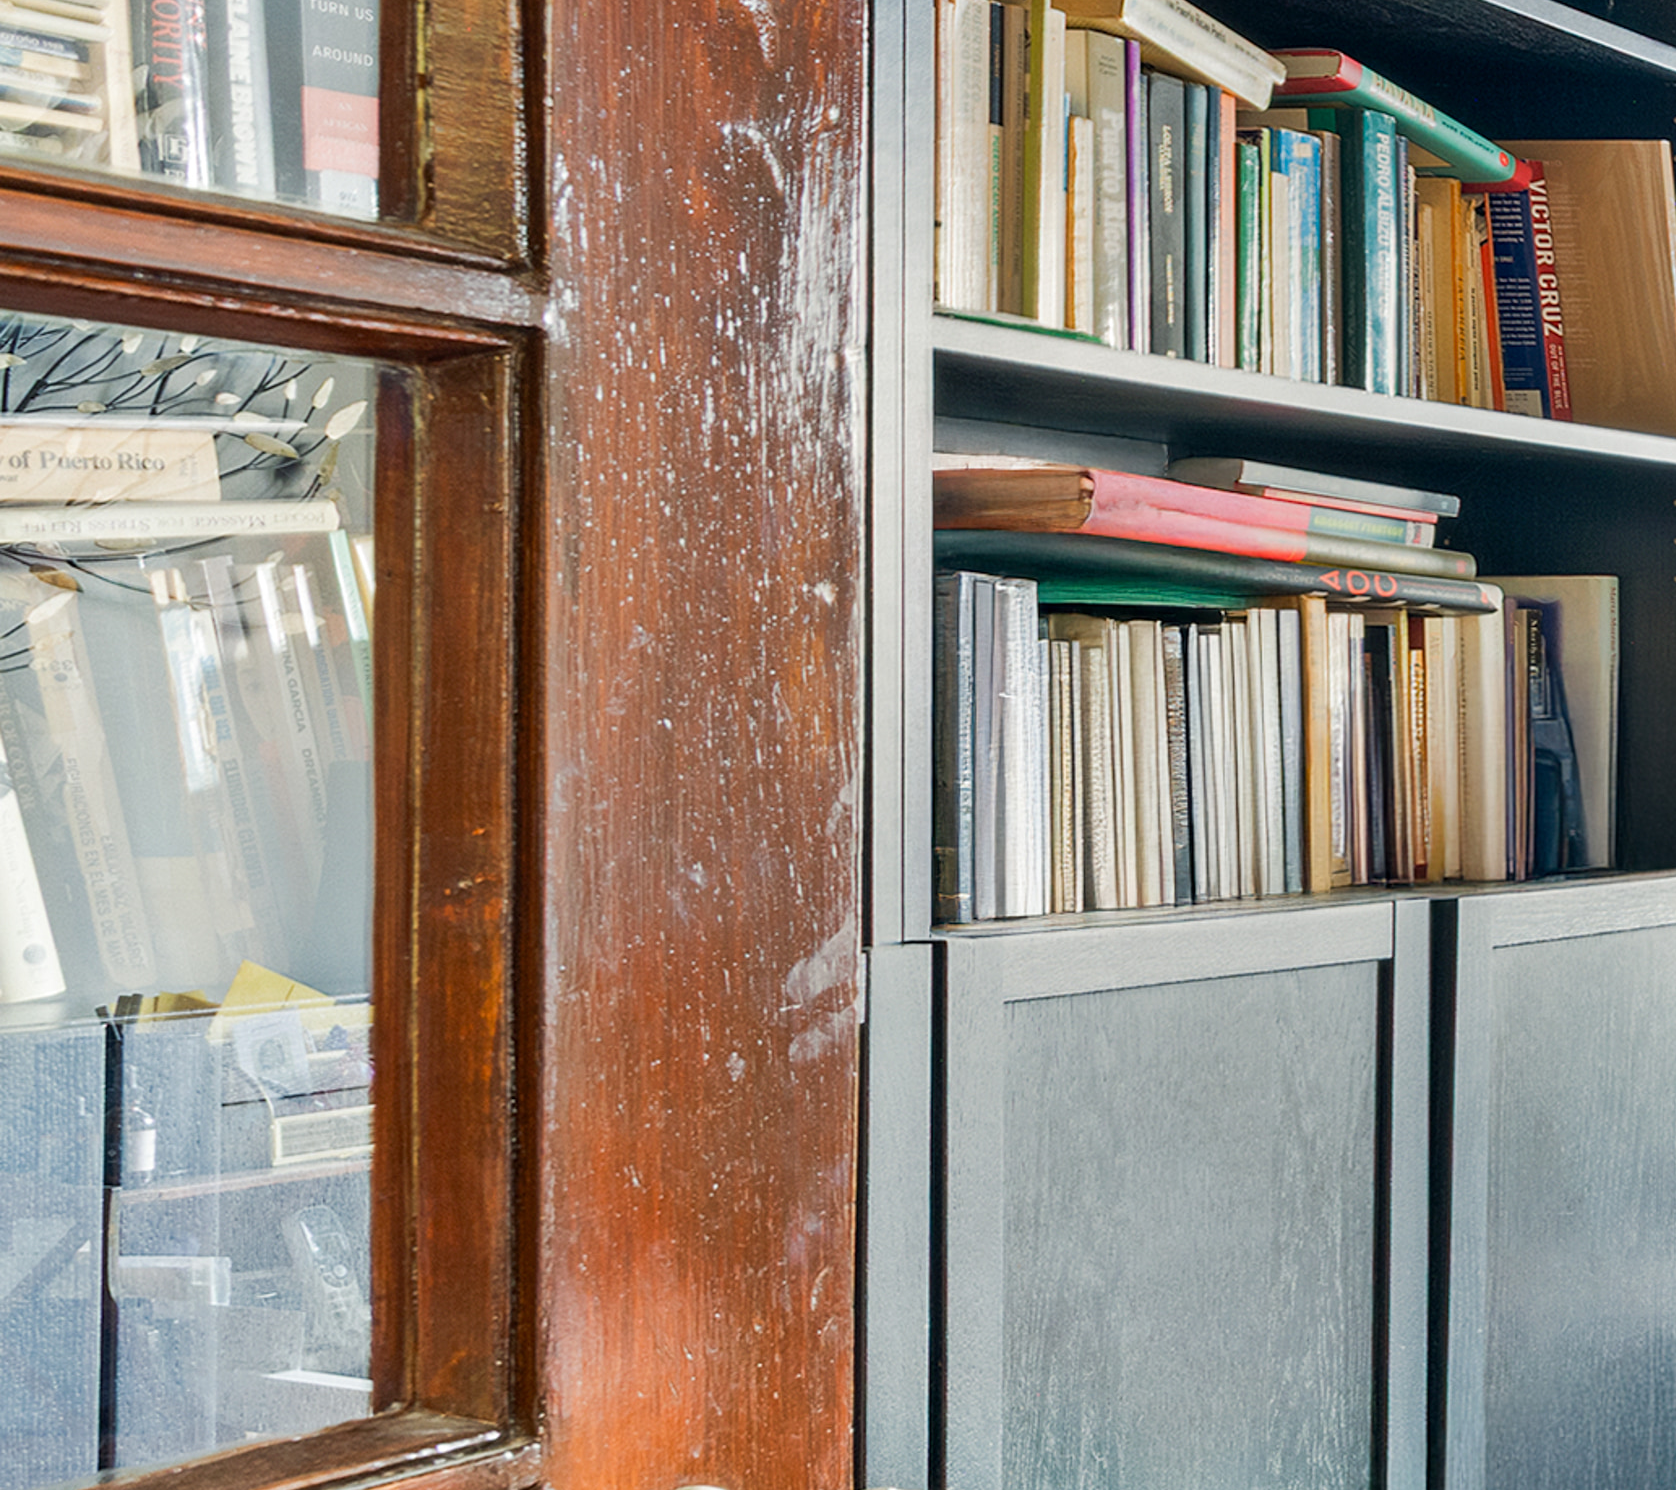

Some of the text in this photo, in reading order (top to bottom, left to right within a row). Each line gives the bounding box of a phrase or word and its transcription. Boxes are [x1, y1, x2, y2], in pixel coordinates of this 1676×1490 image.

[354, 6, 375, 23] US
[311, 43, 375, 68] AROUND
[229, 72, 259, 186] BROWN
[1102, 107, 1126, 256] Puerto Rico
[1528, 179, 1564, 338] VICTOR CRUZ
[9, 448, 166, 472] of Puerto Rico
[19, 511, 327, 535] POCKET MASSAGE FOR STRESS RELIEF
[1318, 569, 1398, 598] AOC
